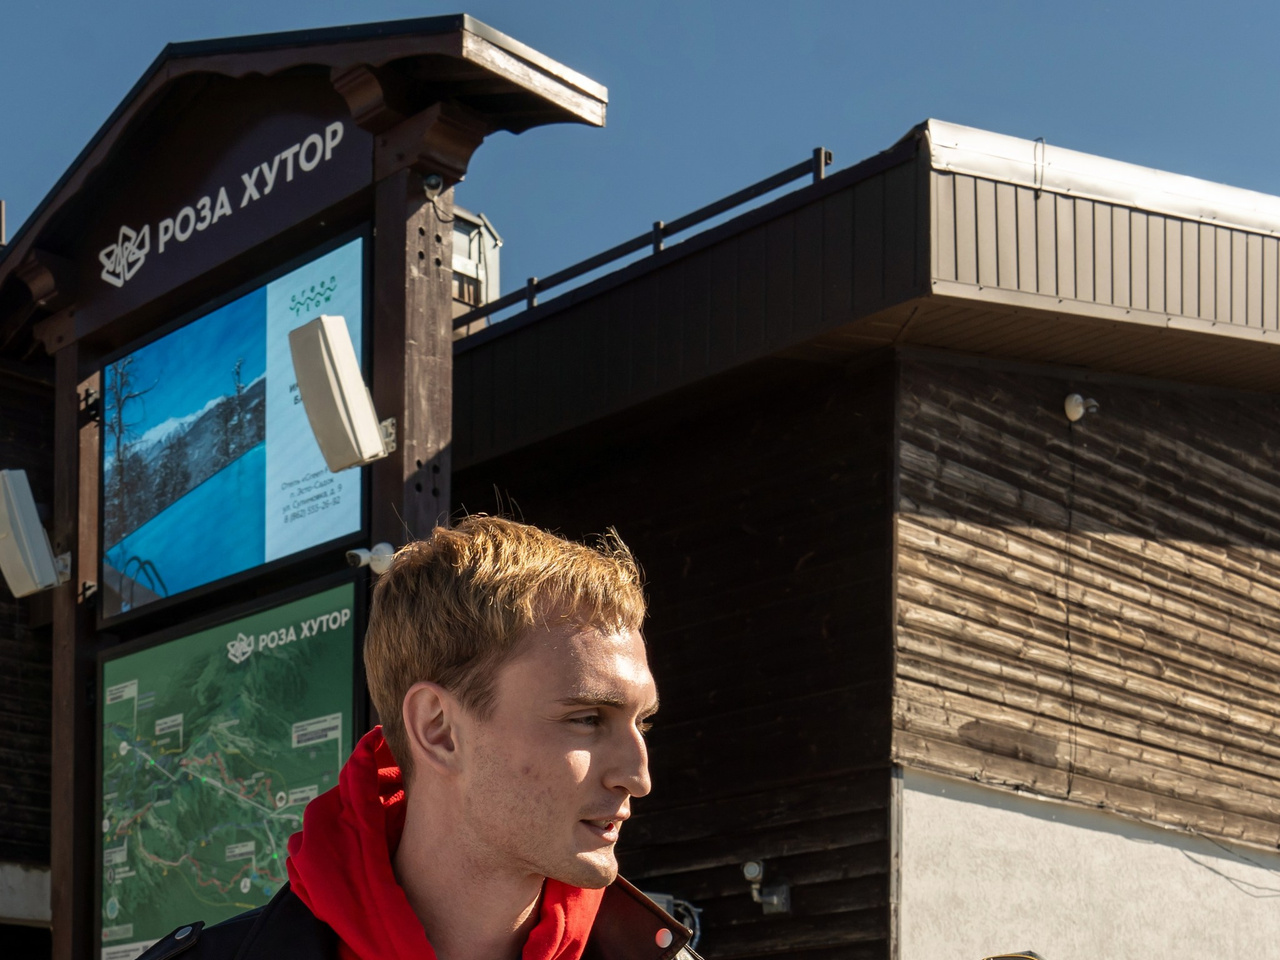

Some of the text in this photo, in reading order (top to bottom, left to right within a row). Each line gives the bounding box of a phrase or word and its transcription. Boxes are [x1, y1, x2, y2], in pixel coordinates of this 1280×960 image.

[157, 121, 344, 253] РОЗА ХУТОР
[258, 608, 351, 652] РОЗА ХУТОР
